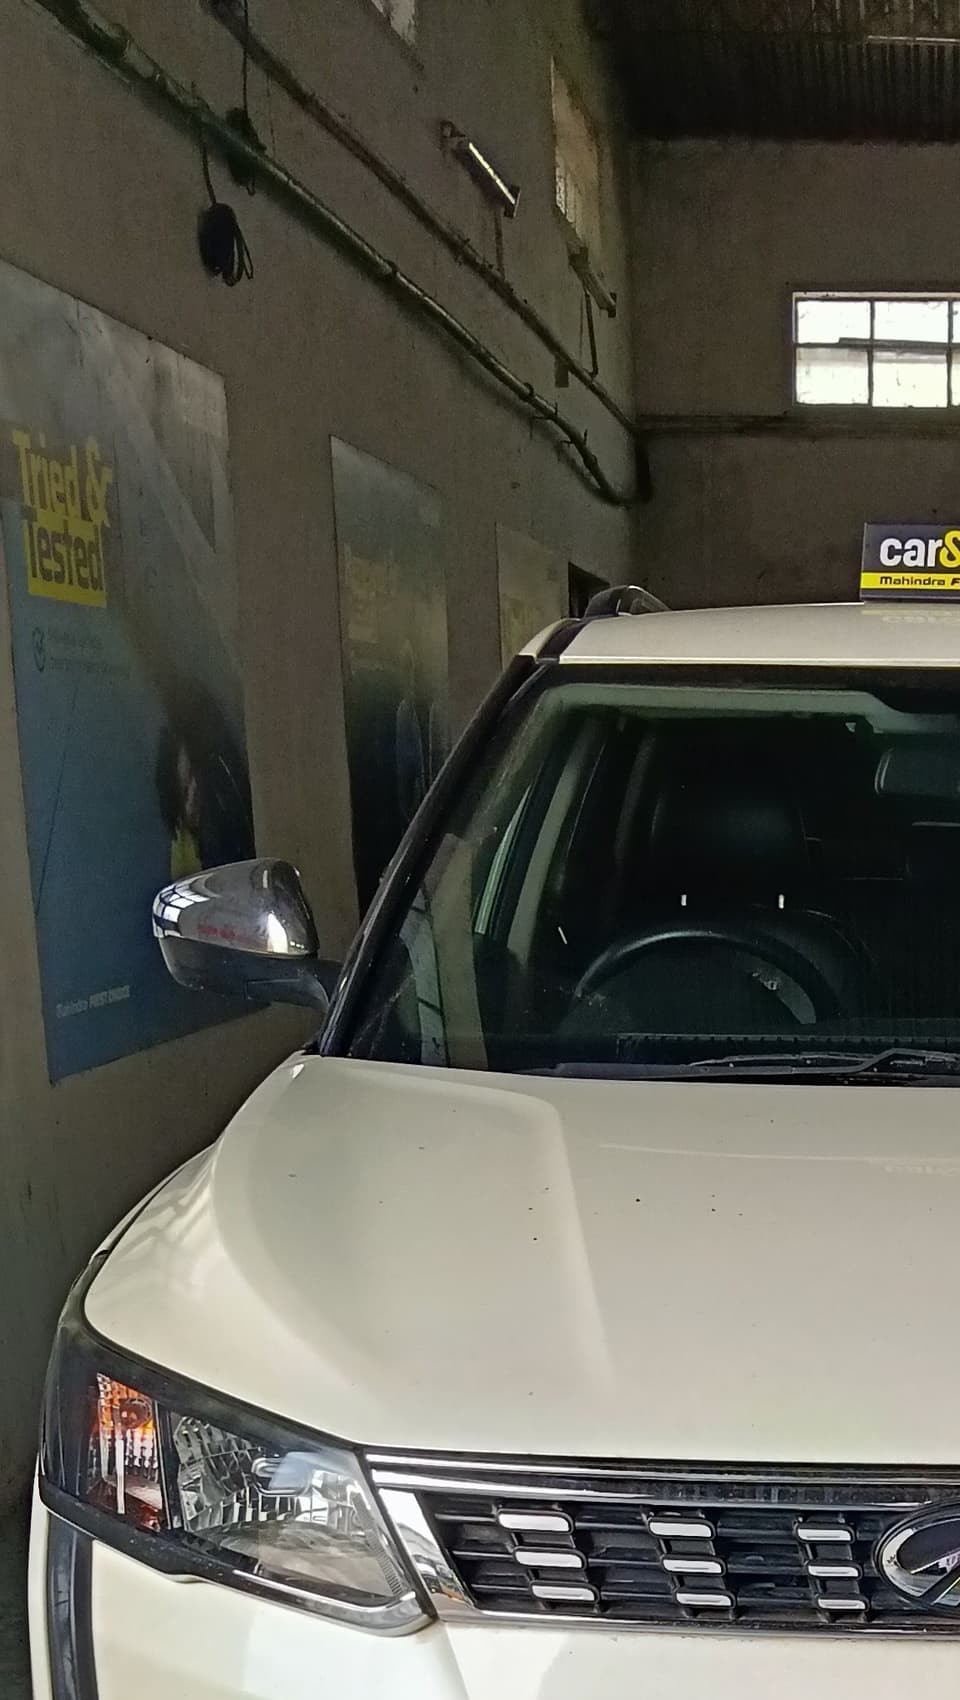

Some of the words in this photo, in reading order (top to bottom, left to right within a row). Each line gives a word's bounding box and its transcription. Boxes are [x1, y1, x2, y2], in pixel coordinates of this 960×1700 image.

[12, 429, 80, 518] Tried
[86, 434, 112, 528] &
[21, 503, 105, 592] Tested
[879, 575, 946, 587] Mahindra
